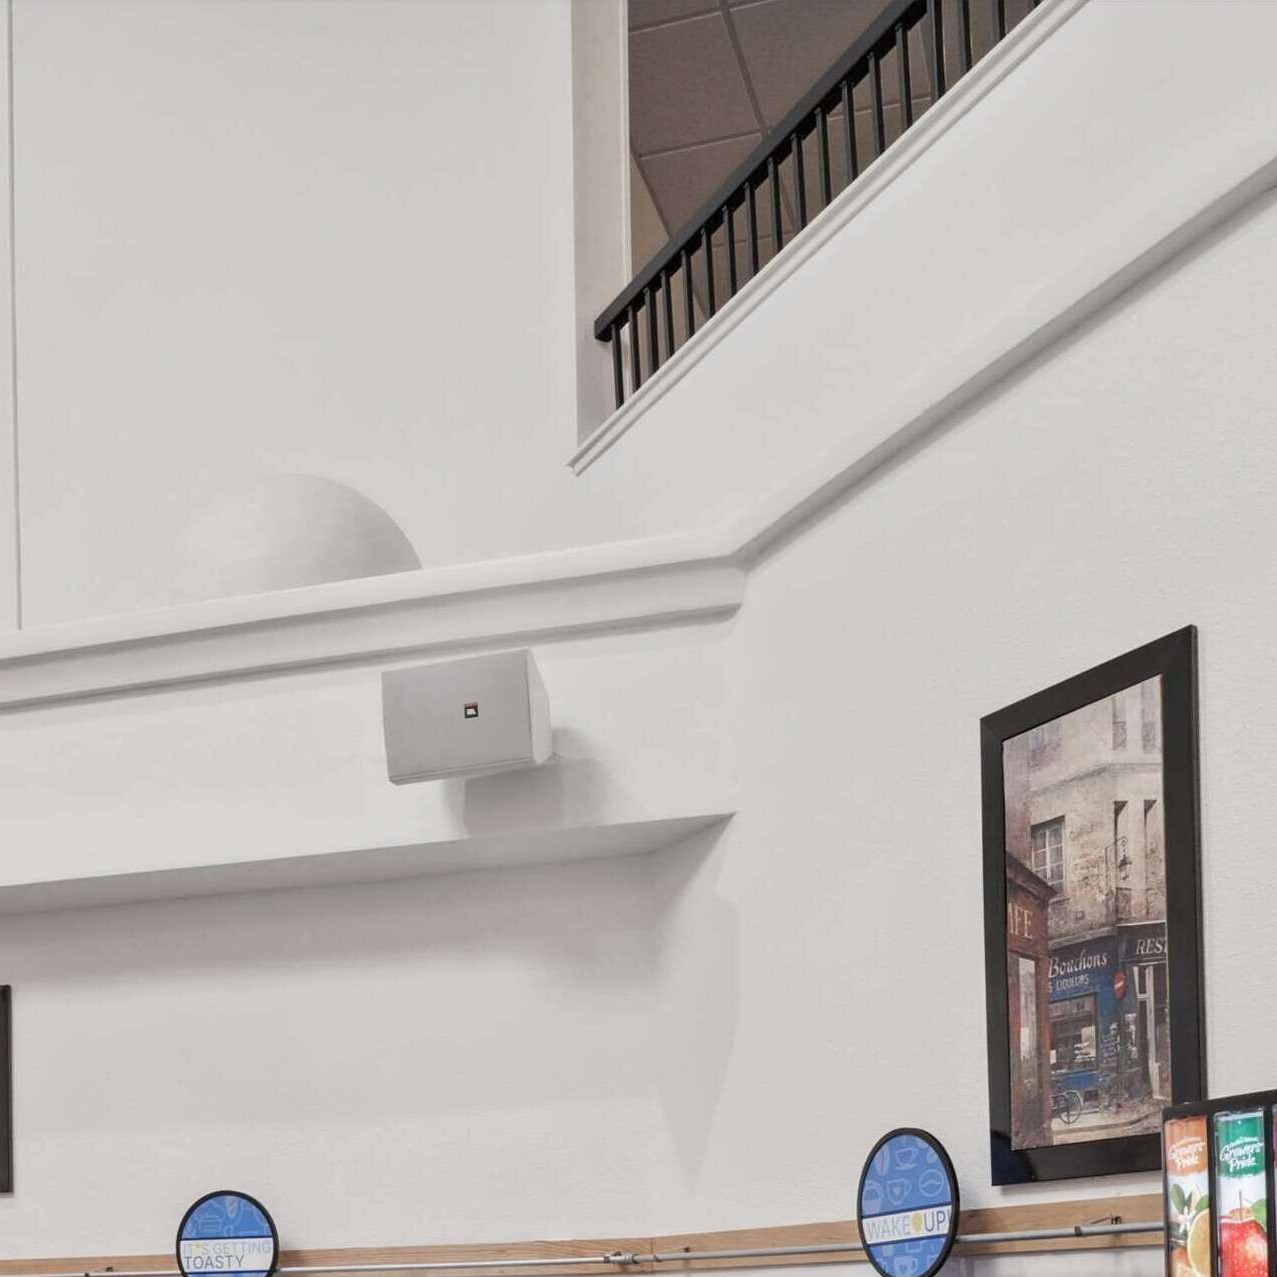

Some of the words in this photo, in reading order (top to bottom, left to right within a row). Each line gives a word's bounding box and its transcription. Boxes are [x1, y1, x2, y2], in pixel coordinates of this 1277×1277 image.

[1049, 949, 1108, 978] Bouchons
[1227, 1154, 1257, 1173] Pride
[865, 1215, 912, 1240] WAKE
[213, 1240, 271, 1255] GETTING
[184, 1255, 244, 1270] TOASTY
